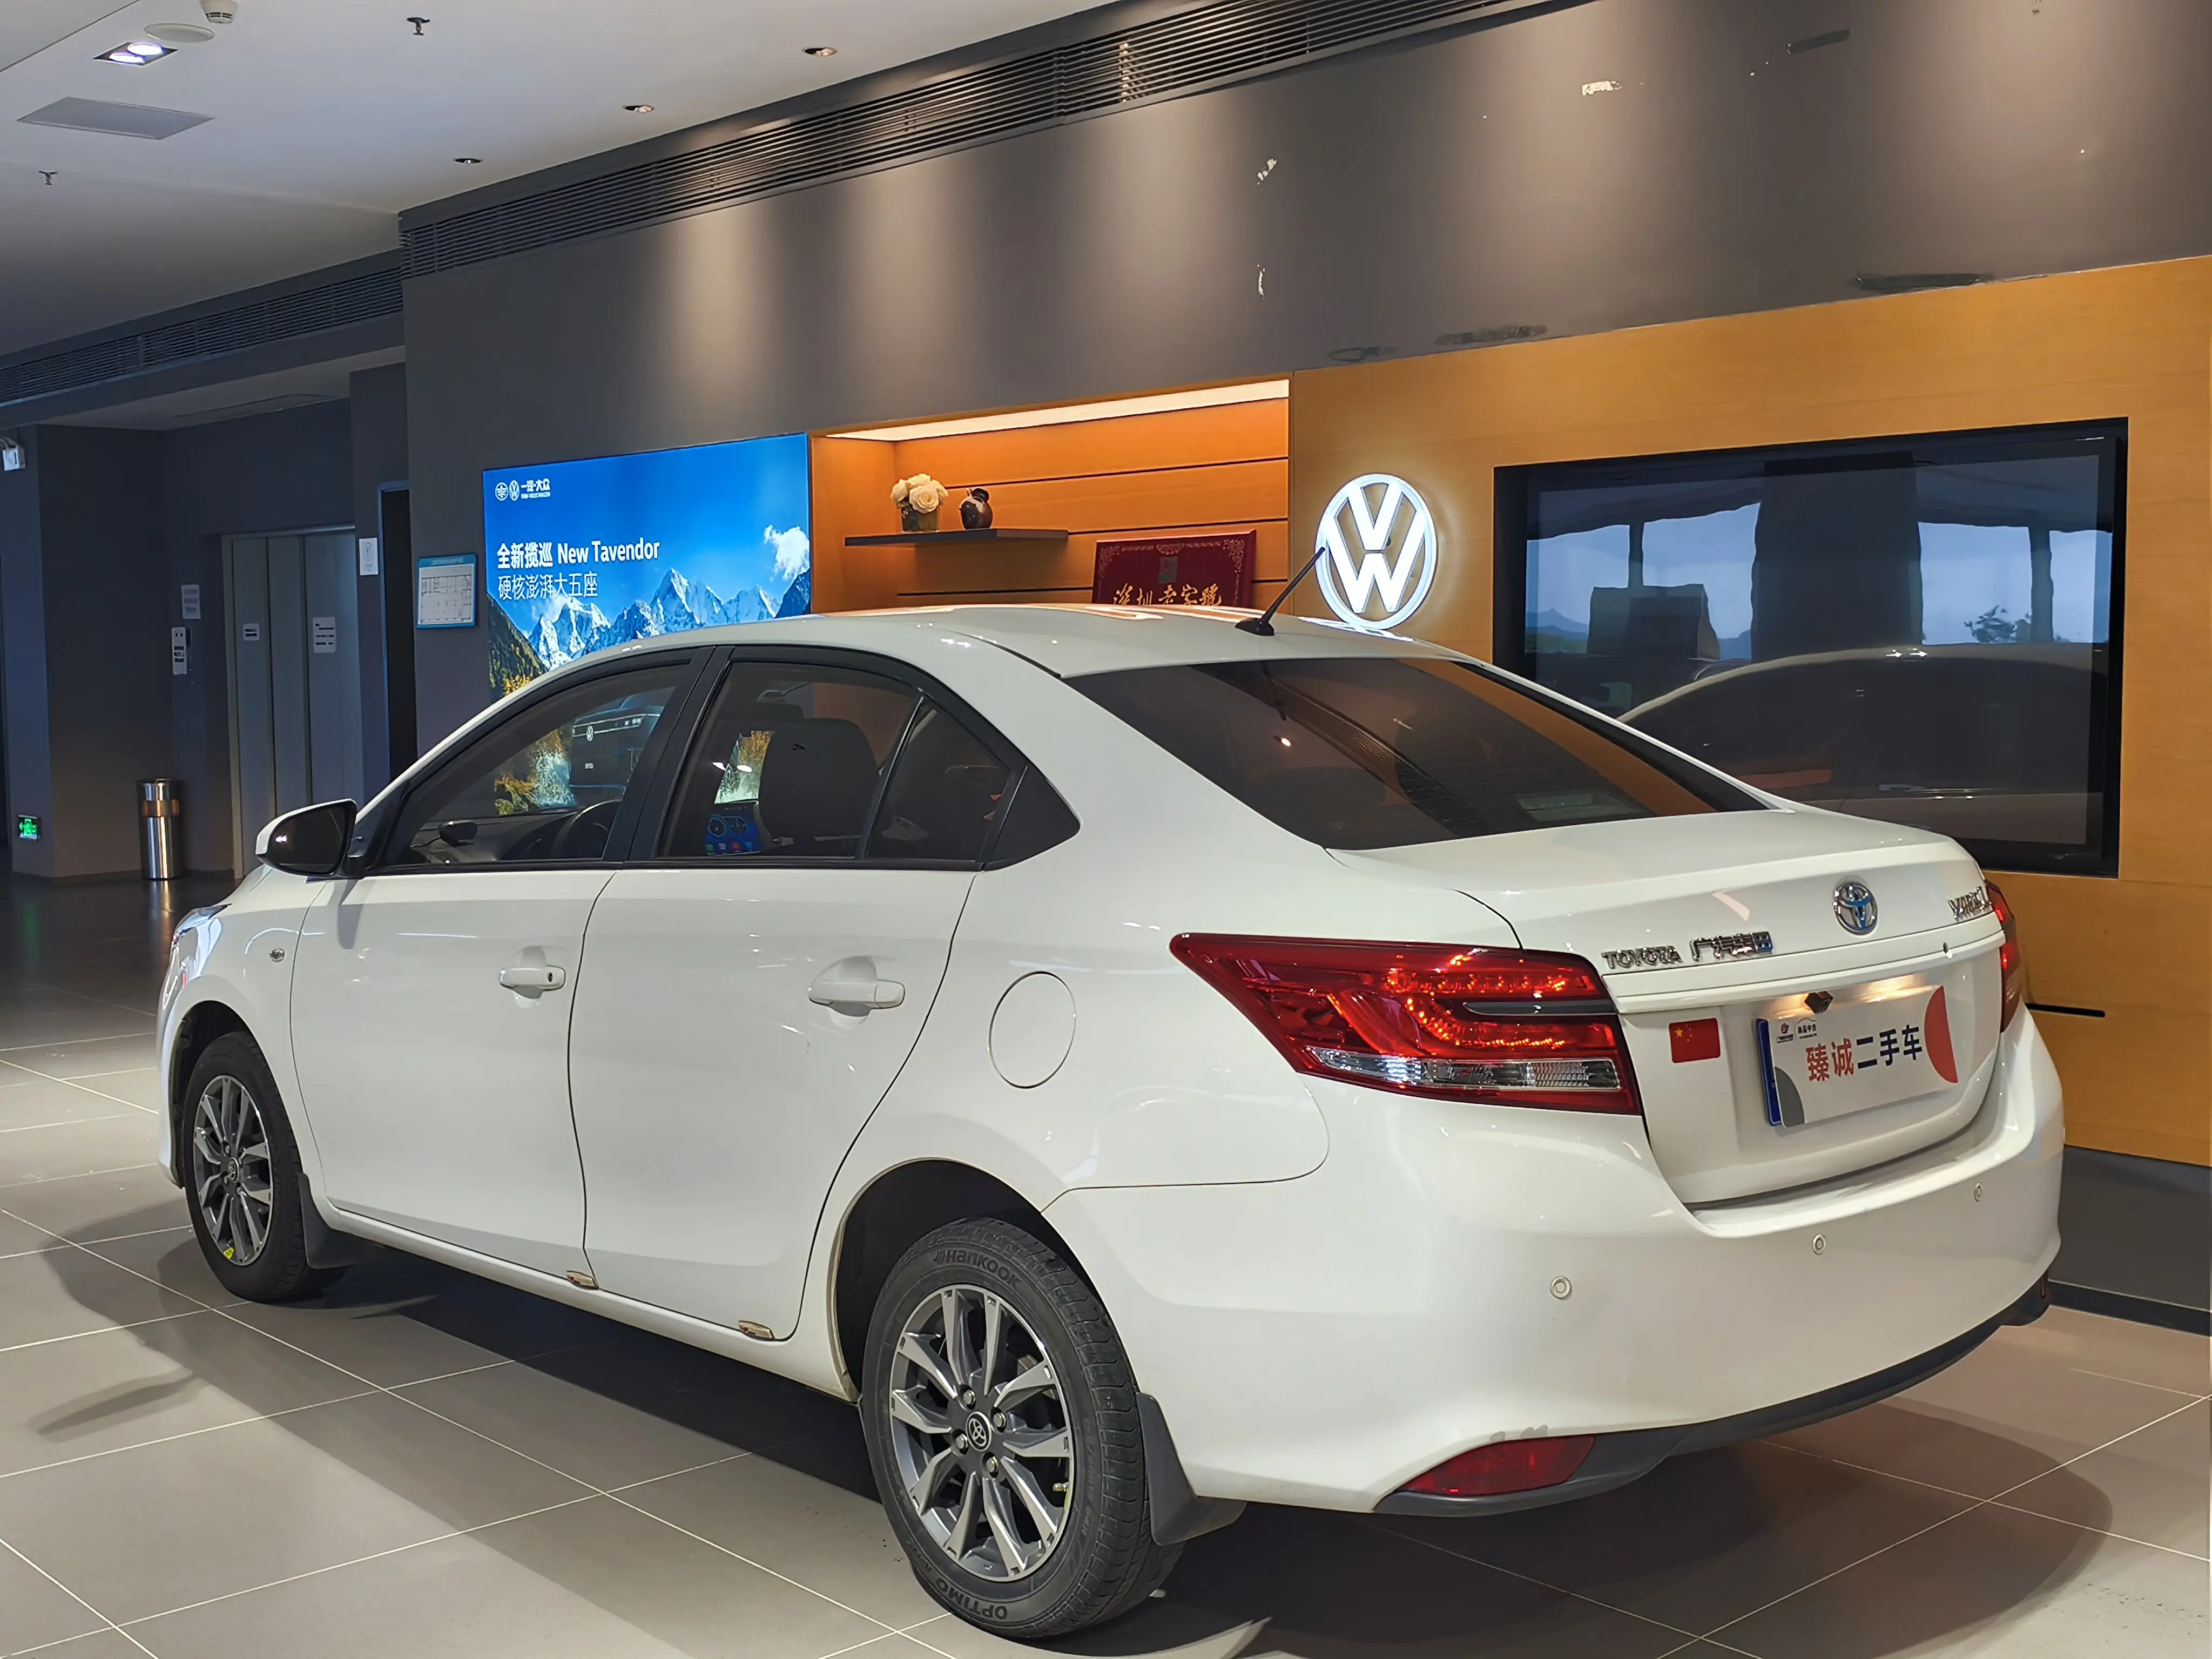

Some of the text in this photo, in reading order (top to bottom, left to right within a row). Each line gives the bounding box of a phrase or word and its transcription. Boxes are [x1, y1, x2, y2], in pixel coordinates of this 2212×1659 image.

[497, 537, 660, 569] 全新揽巡 New Tavendor
[498, 570, 598, 601] 硬核澎湃大五座
[1601, 945, 1683, 969] TOYOTA
[1805, 1024, 1923, 1082] 臻诚二手车
[935, 1577, 1008, 1620] OPTIMO
